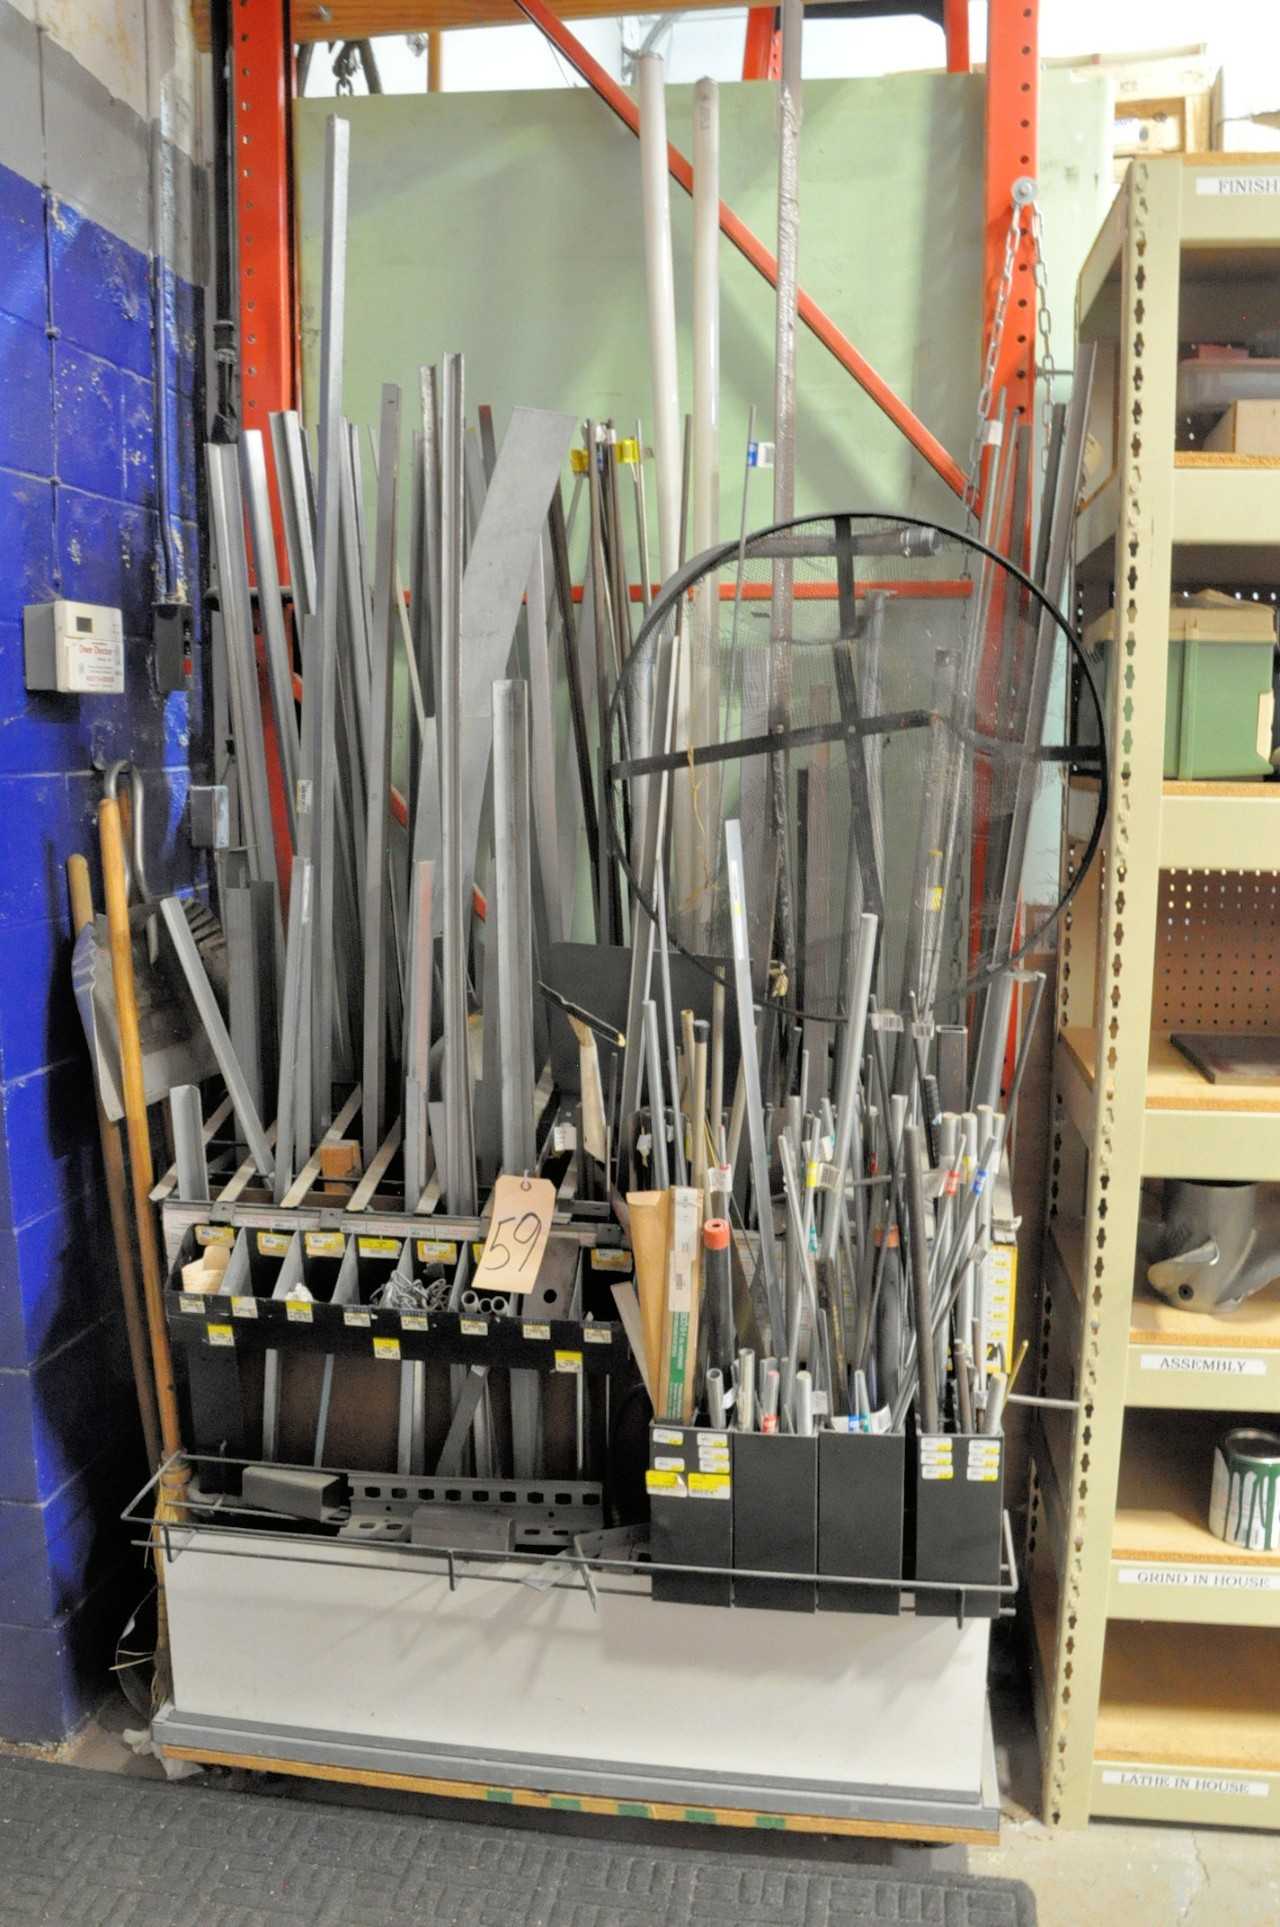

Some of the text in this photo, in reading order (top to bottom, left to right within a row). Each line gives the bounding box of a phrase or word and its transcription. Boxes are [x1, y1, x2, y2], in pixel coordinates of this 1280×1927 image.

[1218, 179, 1279, 193] FINISH
[483, 1212, 543, 1273] 59
[1160, 1357, 1247, 1372] ASSEMBLY
[1137, 1571, 1271, 1589] GRIND IN HOUSE
[1120, 1773, 1250, 1794] LATHE IN HOUSE
